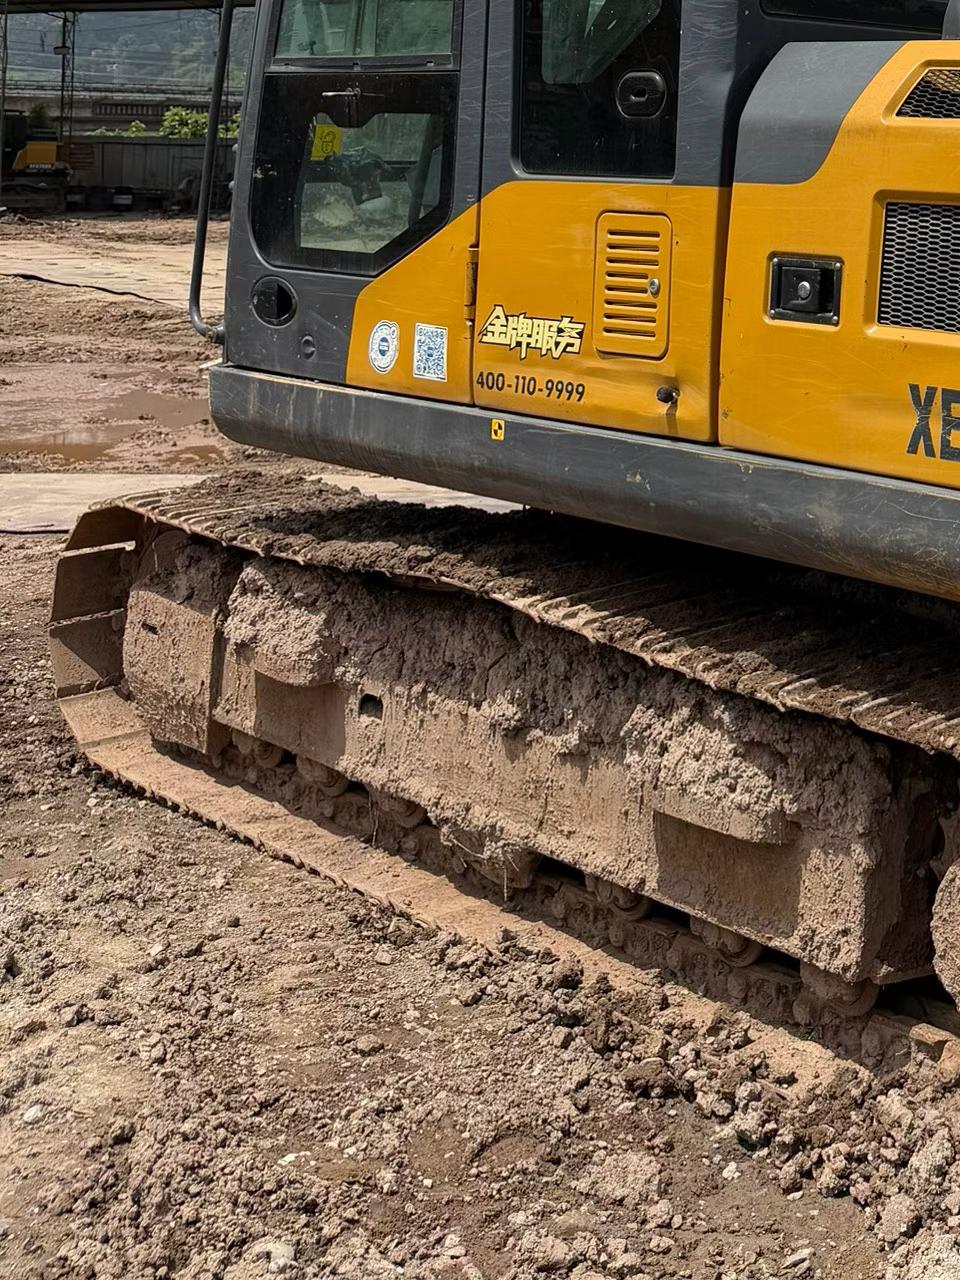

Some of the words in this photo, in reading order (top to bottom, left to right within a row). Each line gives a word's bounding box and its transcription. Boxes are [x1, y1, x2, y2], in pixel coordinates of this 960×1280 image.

[478, 304, 585, 360] 金牌服务
[476, 371, 586, 403] 400-110-9999
